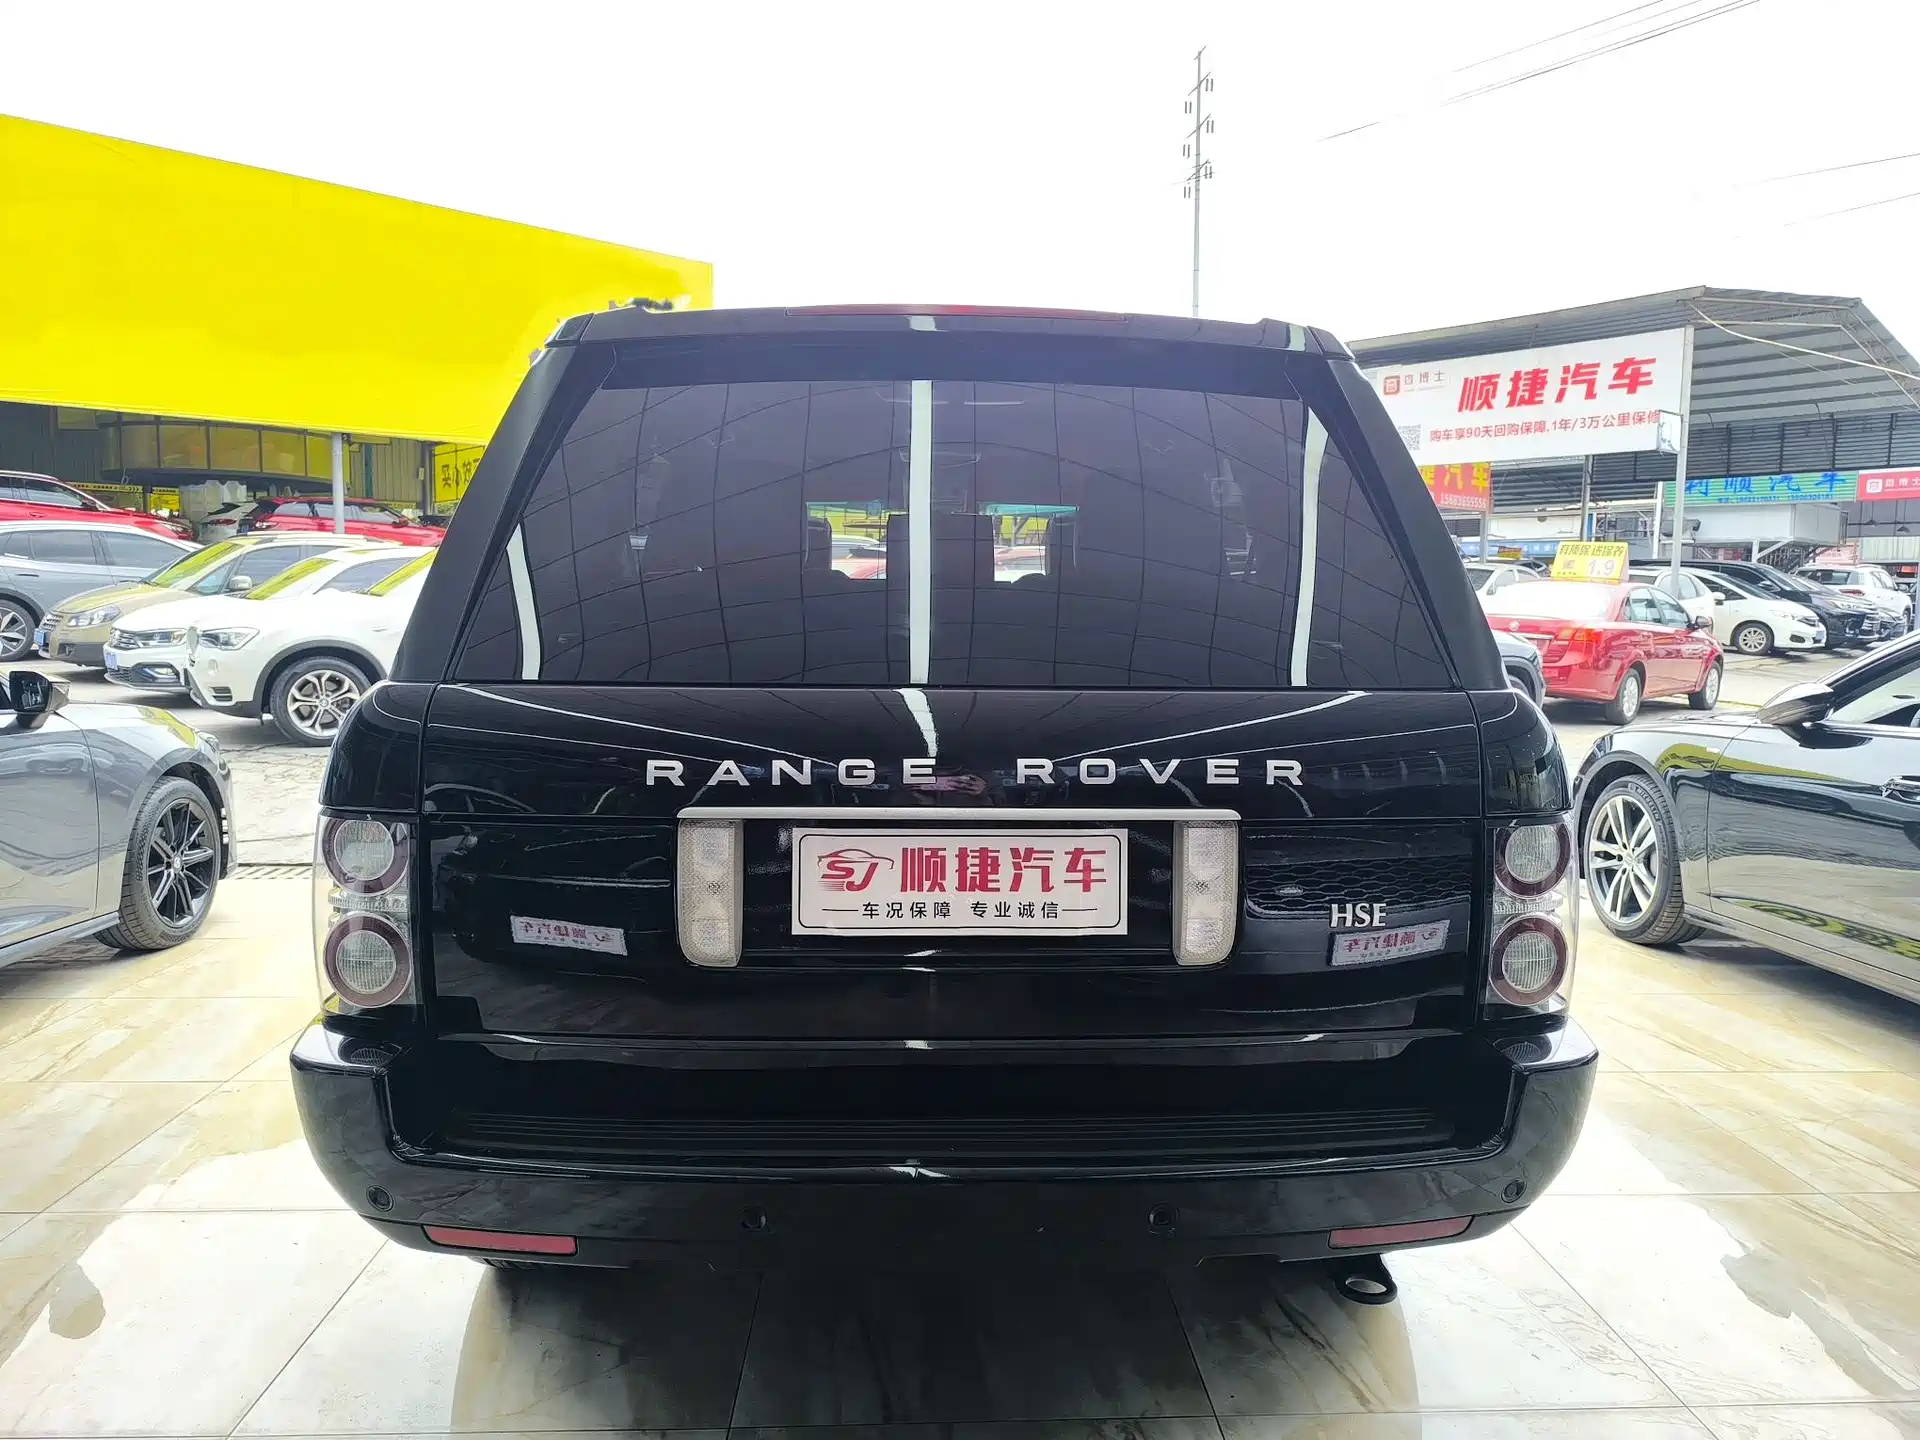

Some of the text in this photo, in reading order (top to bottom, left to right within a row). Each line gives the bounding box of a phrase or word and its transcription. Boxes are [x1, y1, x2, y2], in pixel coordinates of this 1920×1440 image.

[1458, 357, 1656, 412] 顺捷汽车
[645, 758, 1304, 786] RANGE ROVER
[900, 847, 1107, 893] 顺捷汽车
[862, 901, 1060, 918] 车况保障 专业诚信
[1330, 903, 1387, 927] HSE
